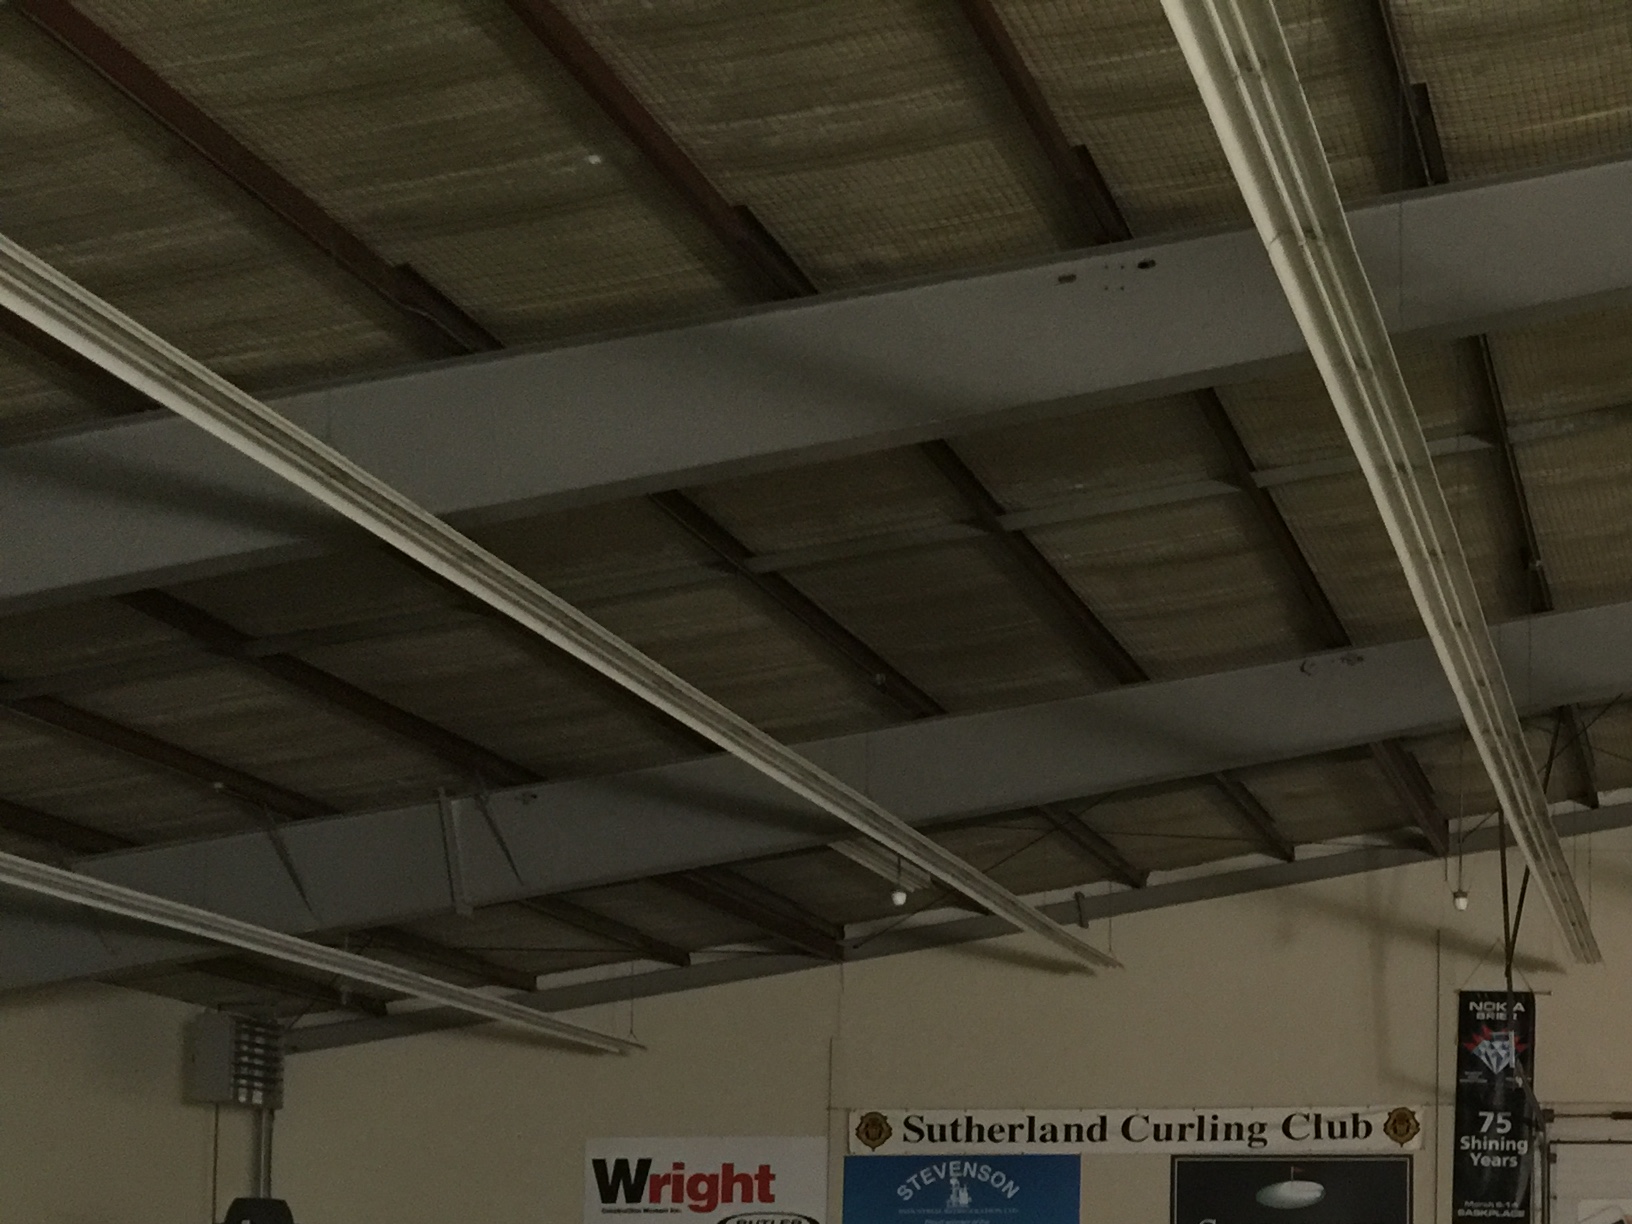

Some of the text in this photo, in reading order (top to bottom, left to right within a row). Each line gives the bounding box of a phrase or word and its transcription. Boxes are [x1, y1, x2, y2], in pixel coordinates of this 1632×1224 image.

[1469, 1002, 1526, 1013] NOKA
[903, 1113, 1373, 1148] Sutherland Curling Club
[1477, 1112, 1512, 1134] 75
[1459, 1135, 1529, 1155] Shining
[1470, 1153, 1518, 1168] Years
[592, 1158, 775, 1213] Wright
[897, 1160, 1020, 1202] STEVENSON
